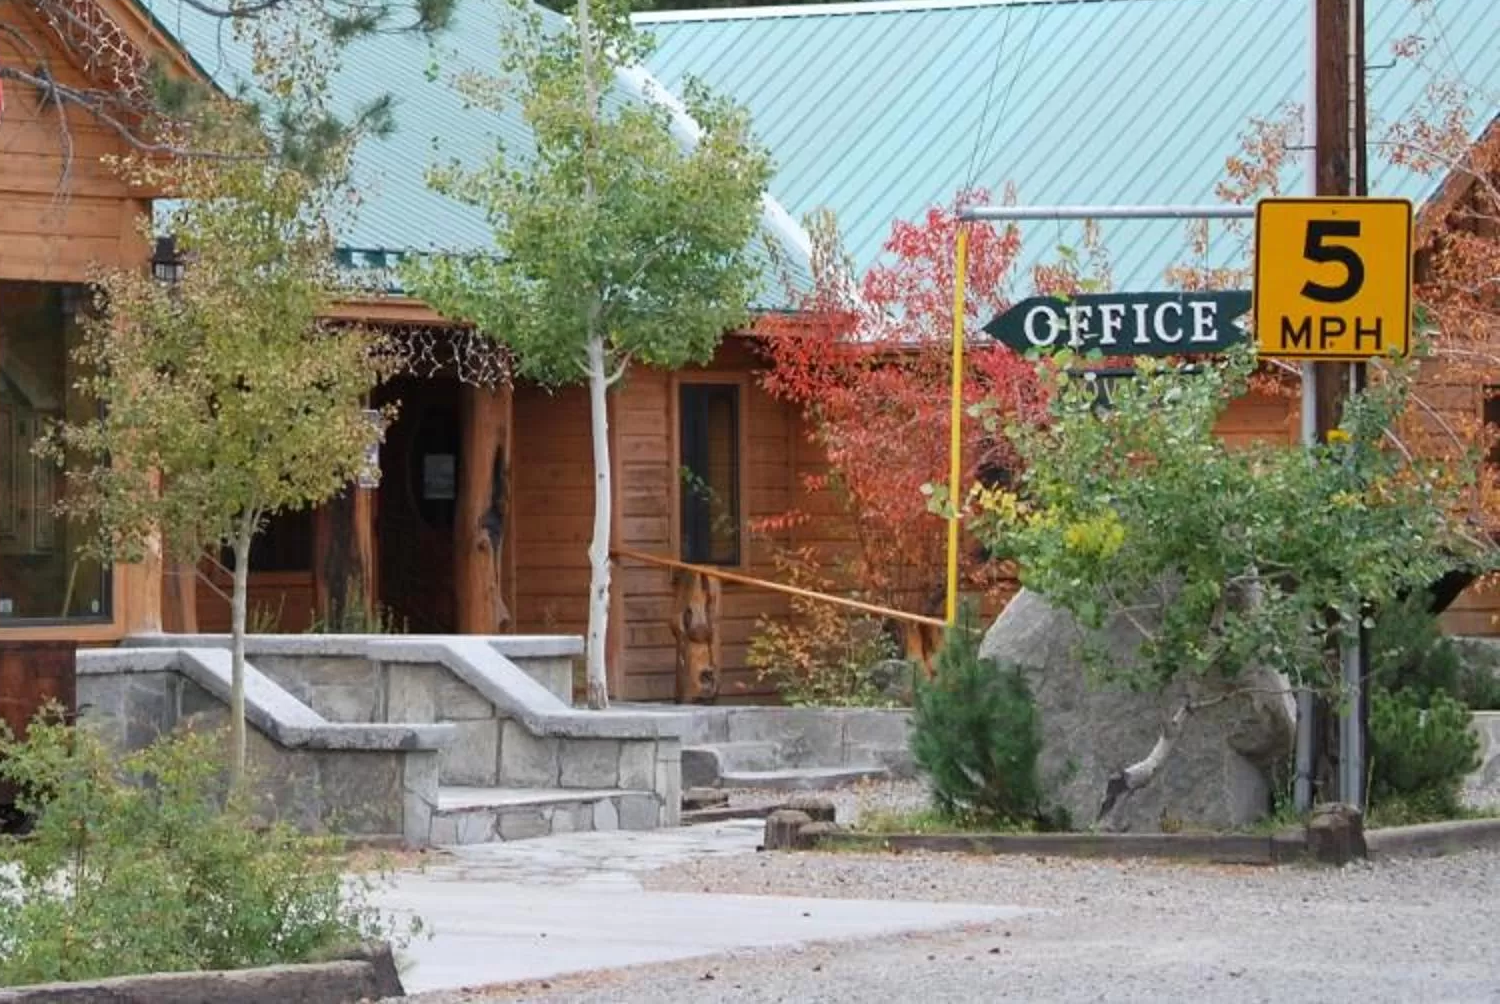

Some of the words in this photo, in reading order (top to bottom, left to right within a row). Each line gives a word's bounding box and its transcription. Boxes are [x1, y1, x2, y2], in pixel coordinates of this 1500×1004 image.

[1300, 219, 1365, 304] 5
[1023, 300, 1218, 346] OFFICE
[1280, 315, 1382, 350] MPH
